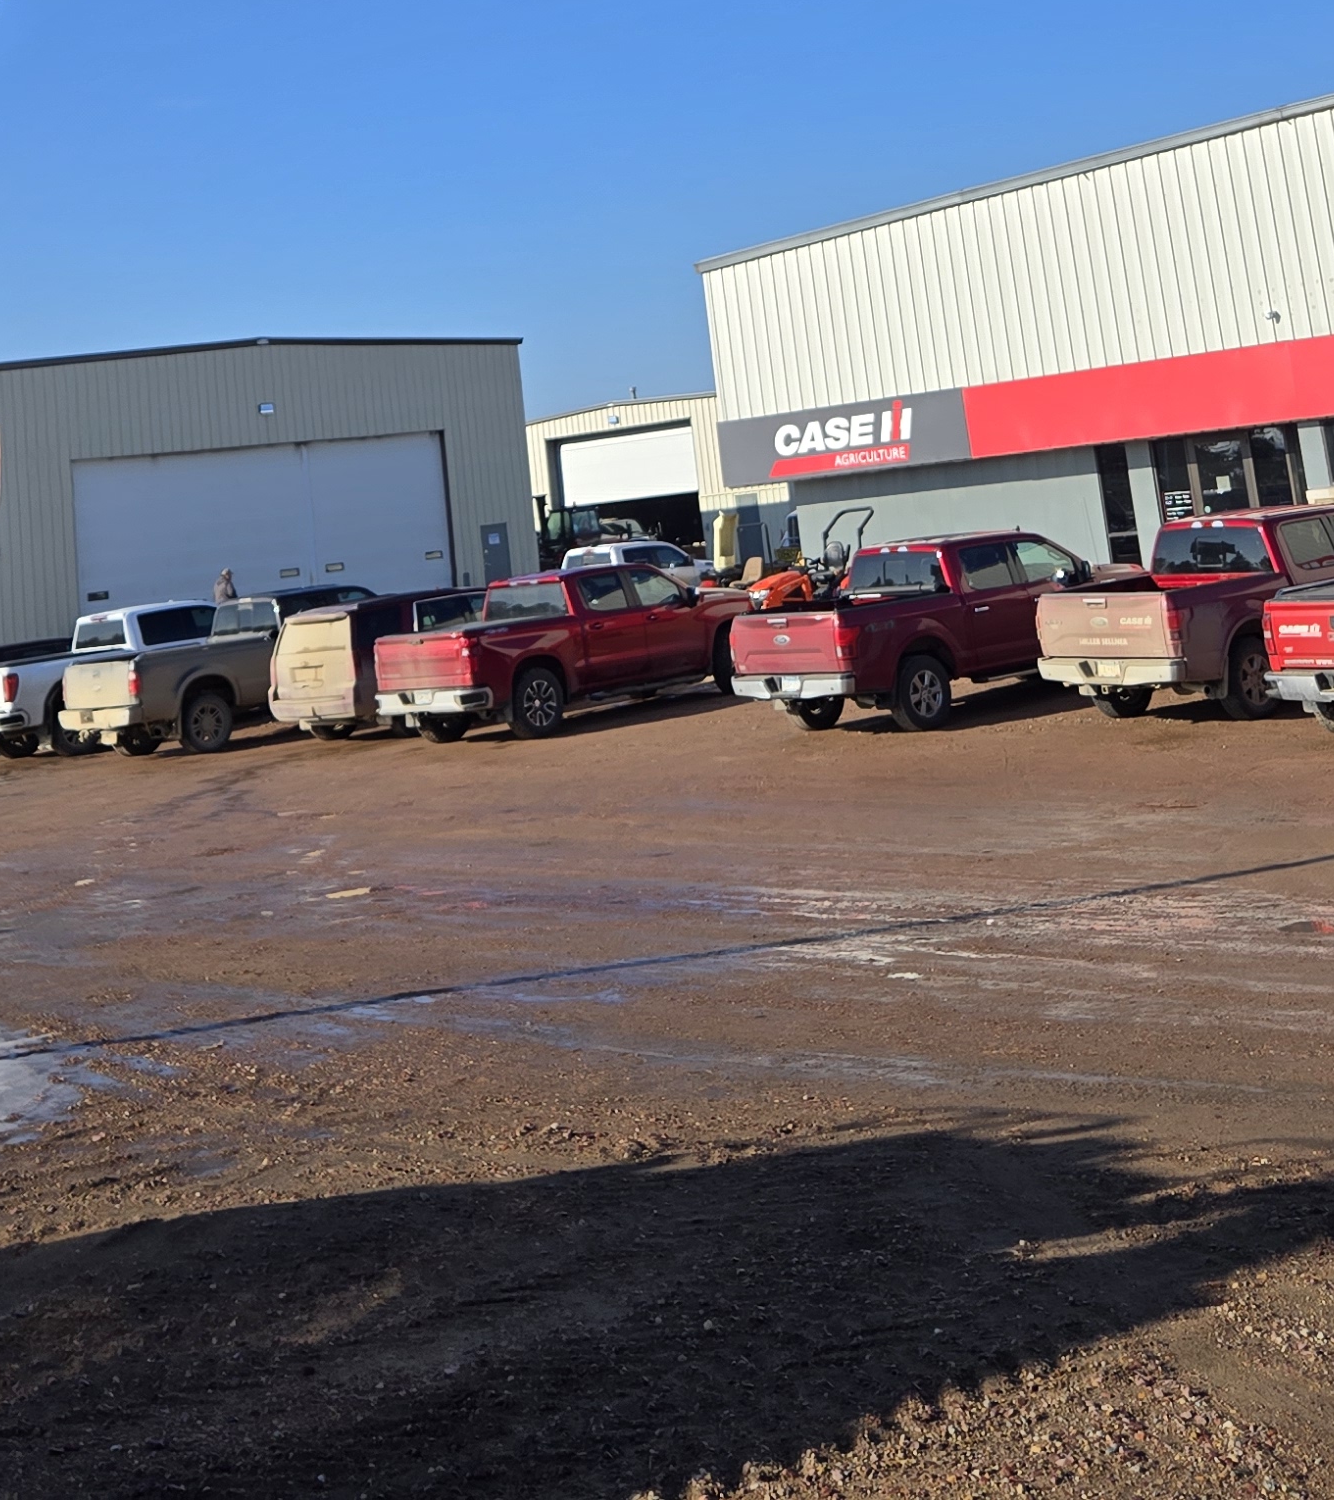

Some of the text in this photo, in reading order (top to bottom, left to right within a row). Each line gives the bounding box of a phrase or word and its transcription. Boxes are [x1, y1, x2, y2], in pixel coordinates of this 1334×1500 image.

[774, 413, 874, 457] CASE
[834, 446, 906, 467] AGRICULTURE
[1119, 617, 1143, 625] CASE
